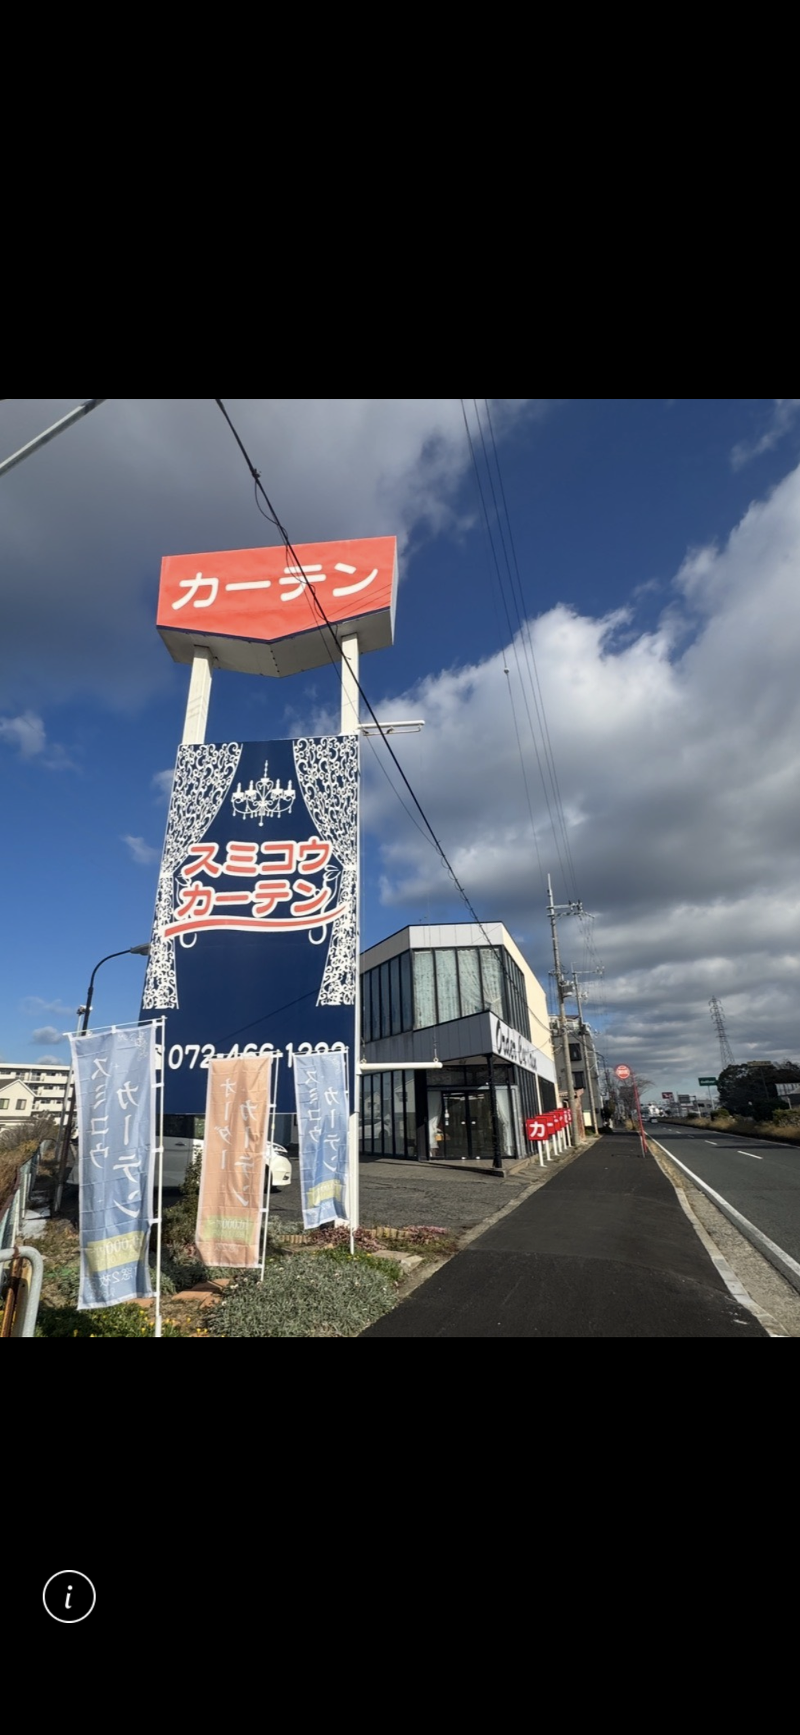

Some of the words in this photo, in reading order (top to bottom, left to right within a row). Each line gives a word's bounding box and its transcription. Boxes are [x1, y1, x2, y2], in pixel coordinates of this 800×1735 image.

[171, 562, 379, 610] カーテン
[180, 835, 334, 878] スミコウ
[173, 879, 331, 920] カーテン
